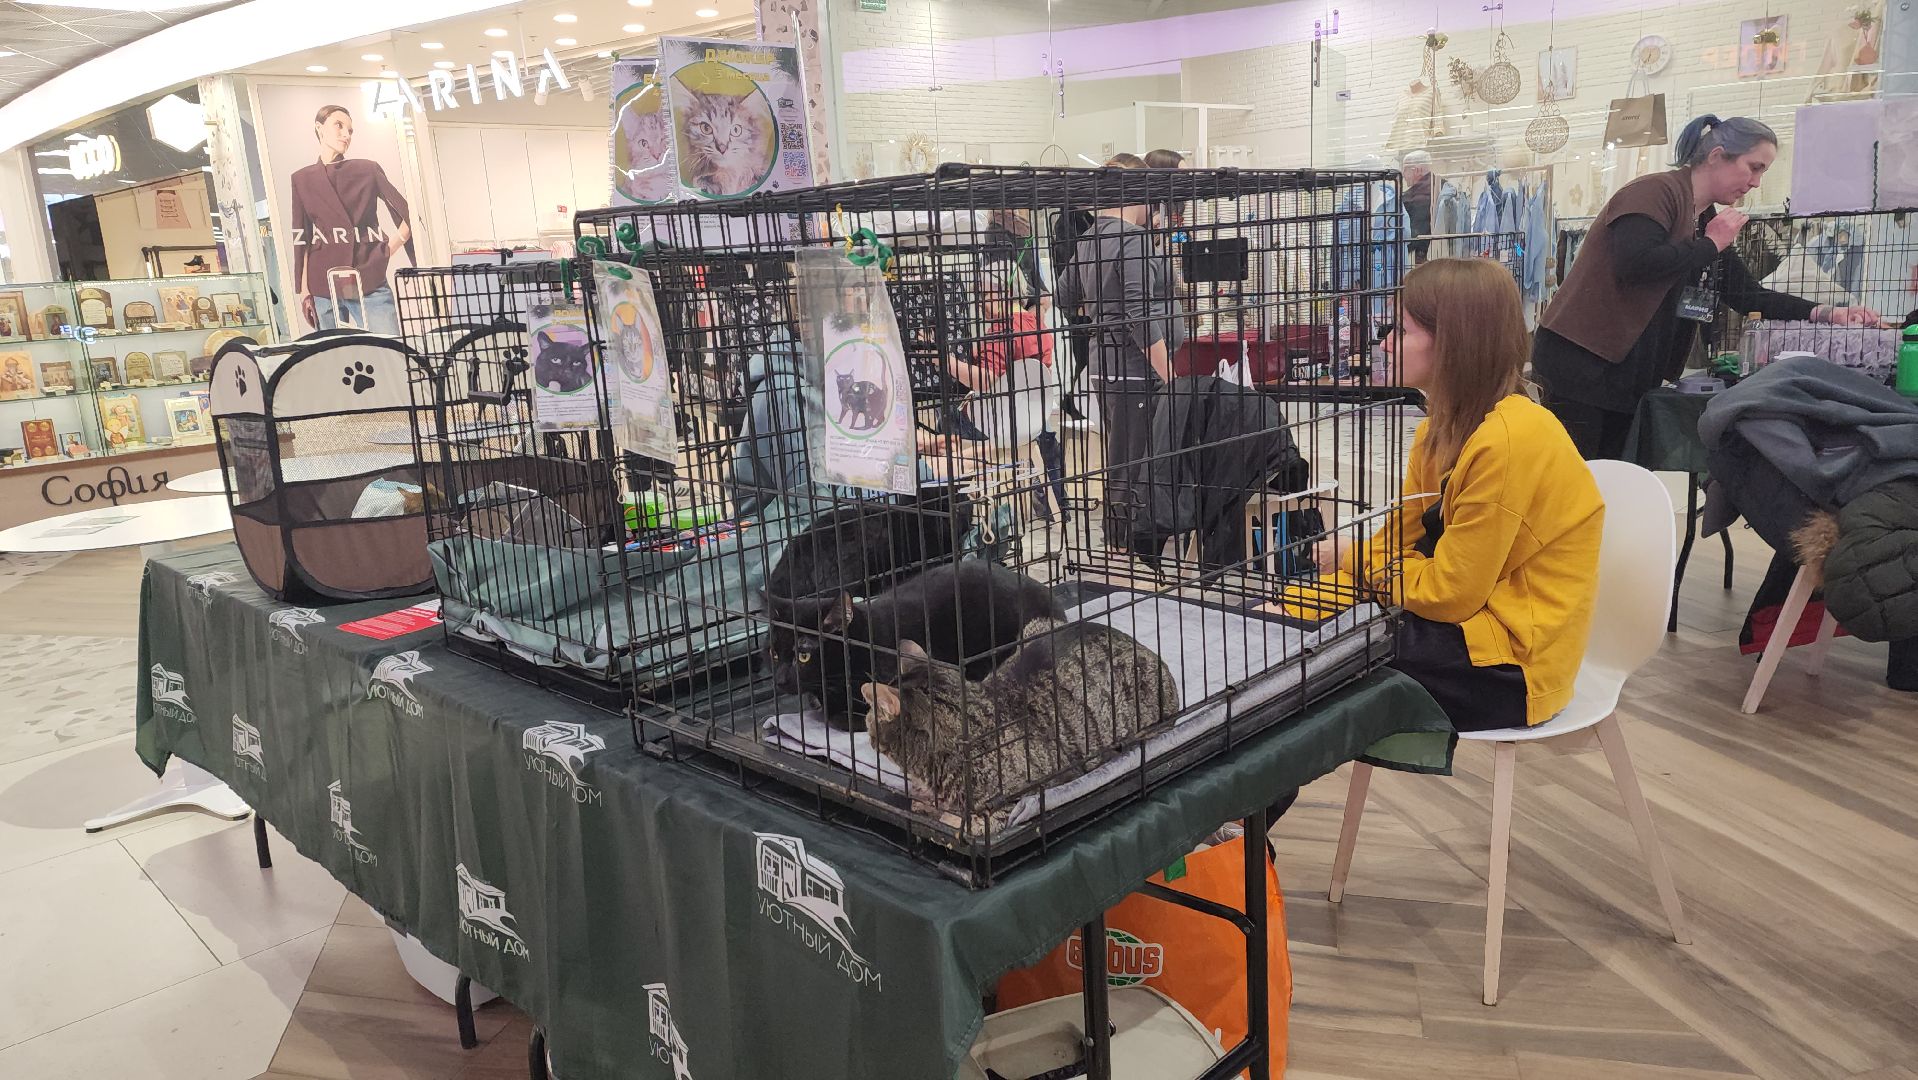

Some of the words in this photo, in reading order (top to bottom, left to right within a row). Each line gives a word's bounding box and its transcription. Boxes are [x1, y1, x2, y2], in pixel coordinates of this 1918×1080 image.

[291, 223, 385, 246] ZARIN
[41, 466, 169, 506] София
[459, 915, 500, 951] ЮТНЫЙ
[503, 938, 531, 963] ДОМ
[757, 891, 831, 961] УЮТНЫЙ
[836, 949, 882, 993] ДОМ
[1067, 938, 1161, 976] Gbus
